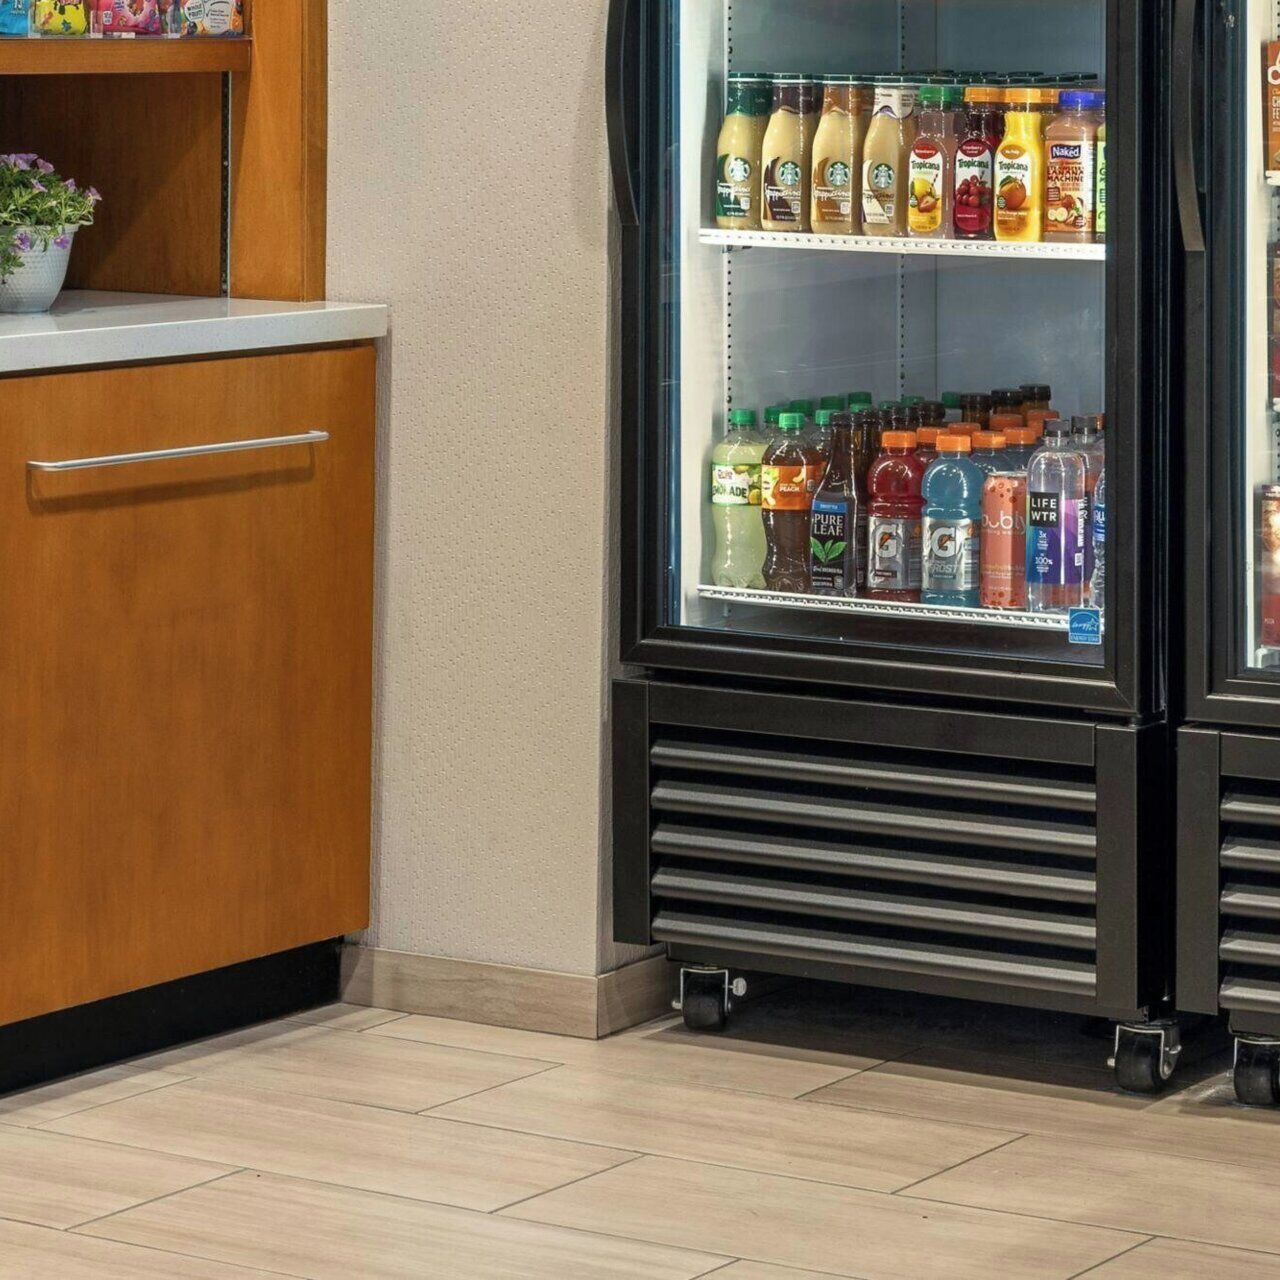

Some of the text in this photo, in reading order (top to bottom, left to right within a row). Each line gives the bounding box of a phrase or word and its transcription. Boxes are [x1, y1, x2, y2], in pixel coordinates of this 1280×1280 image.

[911, 161, 939, 171] Tropicana
[958, 159, 989, 169] Tropicana
[999, 161, 1028, 171] Tropicana
[1031, 498, 1057, 508] LIFE
[814, 514, 843, 525] PURE
[1031, 511, 1057, 522] WTR
